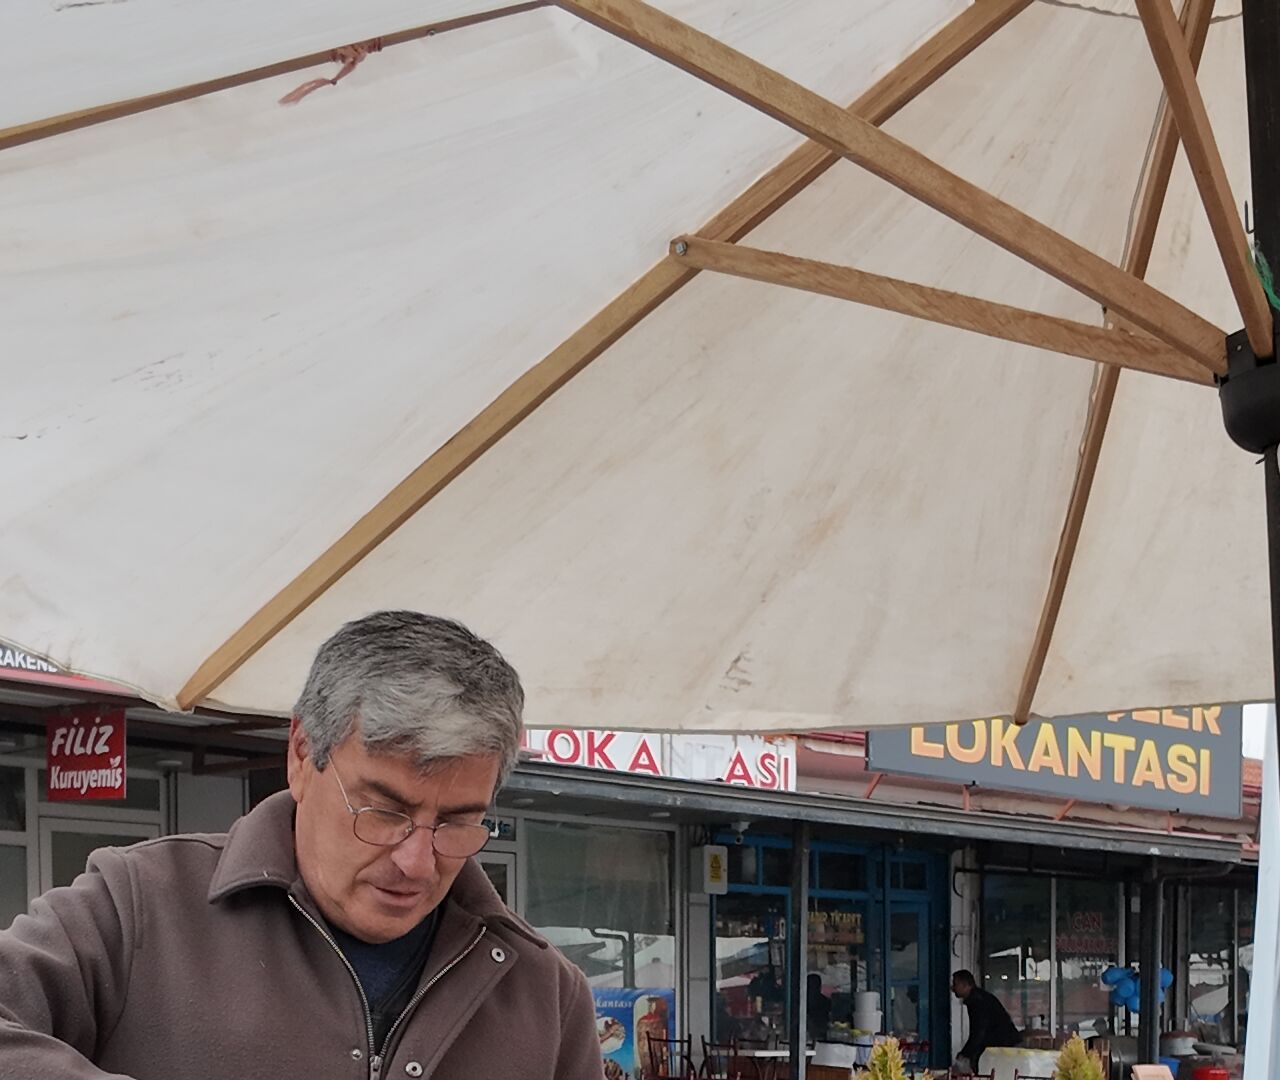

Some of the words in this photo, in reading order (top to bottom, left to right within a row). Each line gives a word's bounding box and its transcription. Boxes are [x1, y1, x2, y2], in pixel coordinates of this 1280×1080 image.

[50, 717, 114, 757] FİLİZ
[50, 759, 122, 794] Kuruyemiş
[911, 718, 1210, 797] LOKANTASI
